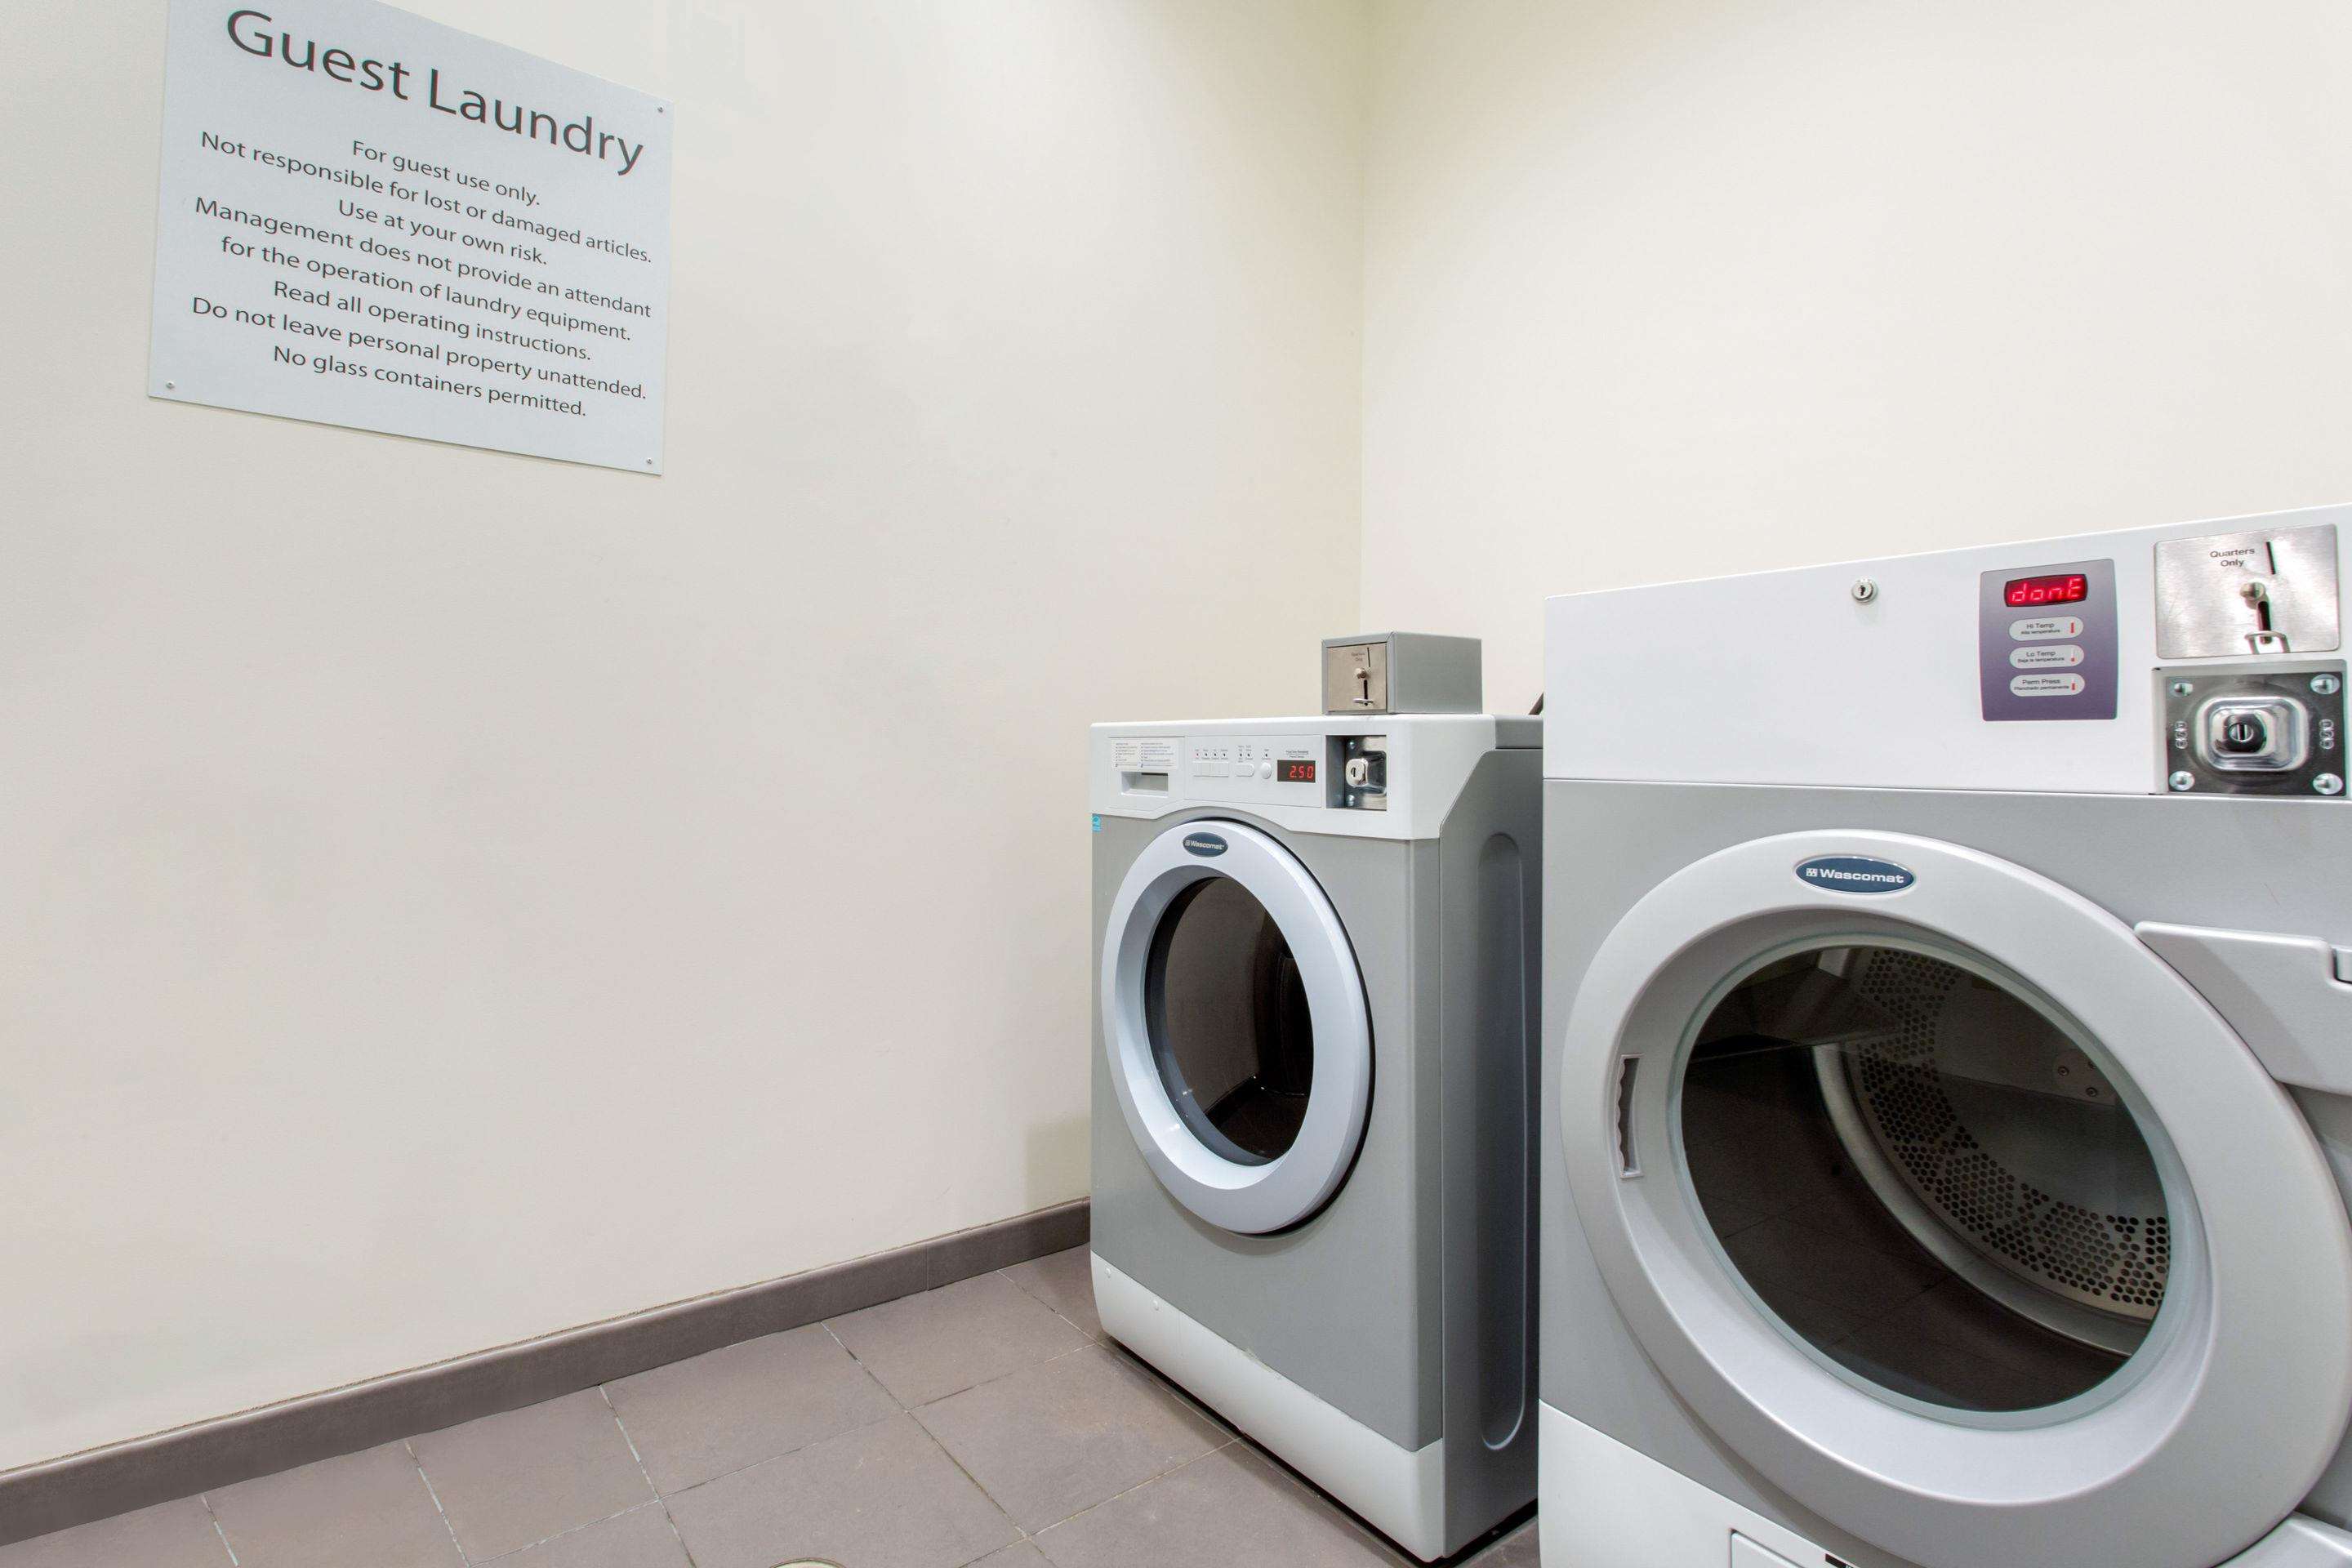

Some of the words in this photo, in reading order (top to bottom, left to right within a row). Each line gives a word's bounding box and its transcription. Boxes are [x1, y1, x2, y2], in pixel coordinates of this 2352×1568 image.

[227, 9, 411, 101] Guest
[429, 68, 644, 176] Laundry
[202, 131, 247, 158] Not
[253, 149, 384, 194] responsible
[389, 180, 419, 203] for
[425, 189, 461, 214] lost
[466, 206, 488, 220] or
[492, 209, 581, 245] damaged
[586, 237, 652, 263] articles.
[353, 140, 388, 163] For
[392, 155, 451, 181] guest
[457, 172, 490, 192] use
[495, 184, 540, 207] only.
[195, 196, 354, 249] Management
[359, 237, 411, 262] does
[417, 253, 452, 273] not
[457, 263, 532, 291] provide
[537, 281, 559, 296] an
[564, 288, 652, 318] attendant
[339, 198, 378, 224] Use
[384, 215, 405, 230] at
[409, 220, 457, 243] your
[461, 234, 505, 255] own
[510, 244, 547, 265] risk.
[220, 235, 256, 258] for
[261, 246, 301, 269] the
[306, 260, 413, 294] operation
[419, 283, 443, 299] of
[446, 286, 522, 319] laundry
[526, 309, 630, 341] equipment.
[274, 280, 330, 307] Read
[336, 296, 362, 314] all
[368, 305, 470, 339] operating
[476, 323, 590, 361] instructions.
[193, 296, 228, 318] Do
[235, 309, 276, 329] not
[283, 314, 342, 341] leave
[348, 332, 440, 360] personal
[446, 350, 532, 381] property
[537, 368, 646, 399] unattended.
[274, 345, 306, 366] No
[313, 354, 368, 378] glass
[374, 368, 483, 399] containers
[488, 389, 586, 416] permitted.
[2209, 548, 2256, 558] Quarters
[2221, 559, 2244, 567] Only
[1191, 840, 1224, 850] Wascomat
[1819, 868, 1904, 884] Wascomat
